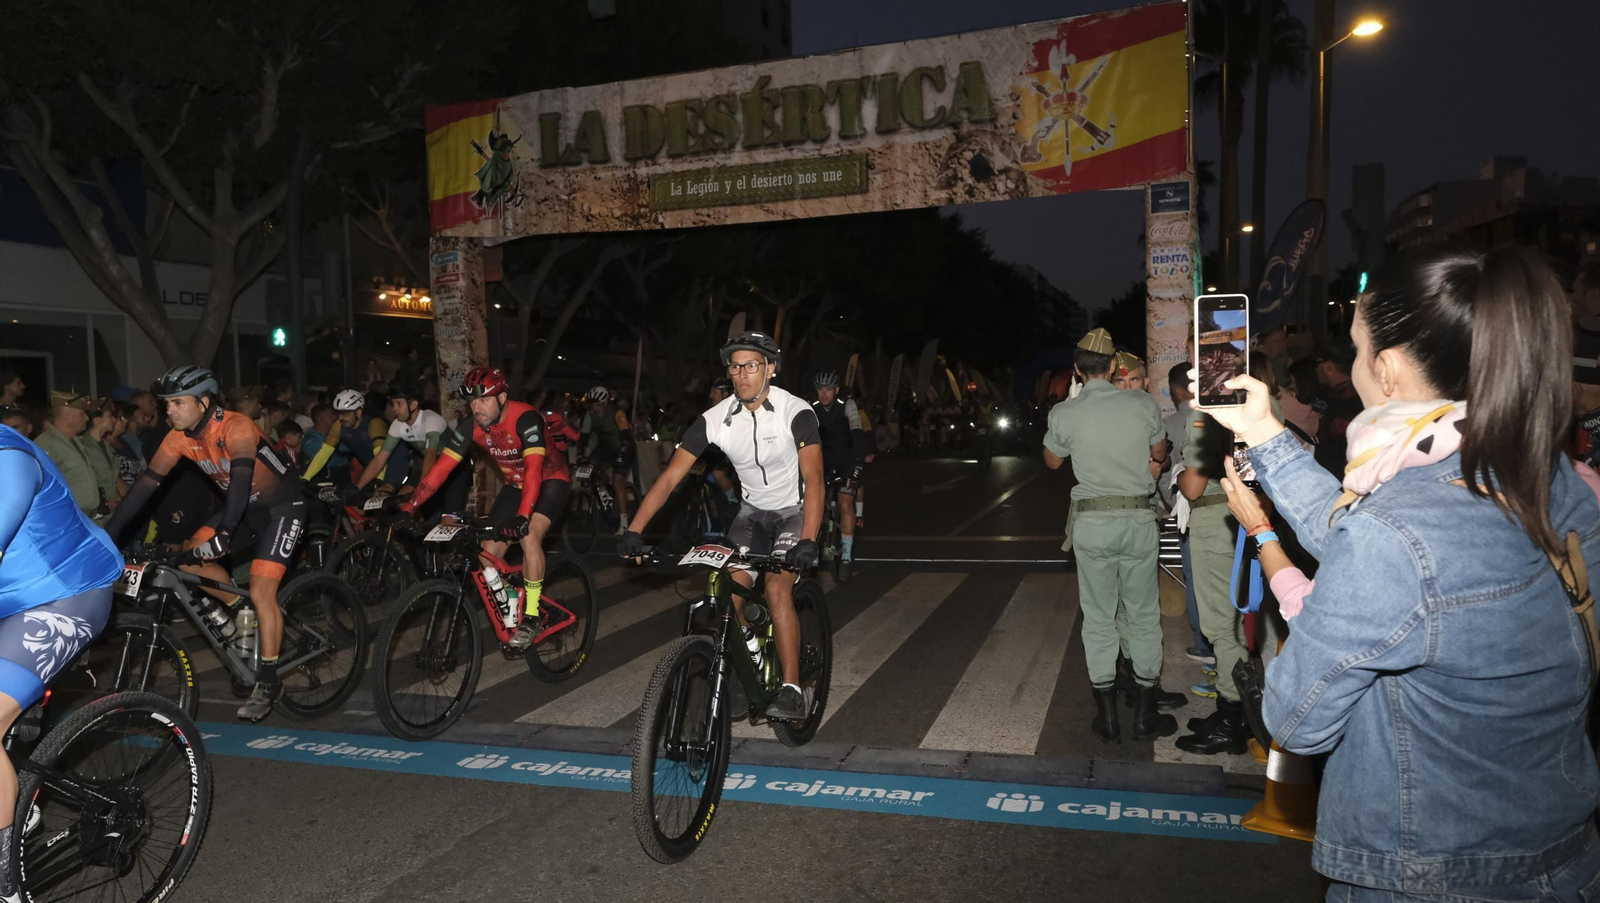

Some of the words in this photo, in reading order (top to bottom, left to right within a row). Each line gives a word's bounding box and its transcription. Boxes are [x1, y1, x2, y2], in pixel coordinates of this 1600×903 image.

[538, 110, 611, 169] LA
[622, 60, 998, 162] DESÉRTICA
[670, 182, 682, 196] La
[686, 179, 720, 197] Legión
[724, 180, 732, 194] y
[736, 176, 747, 190] el
[750, 173, 793, 188] desierto
[798, 172, 818, 185] nos
[822, 169, 843, 183] une
[1152, 246, 1189, 254] GRUPO
[1152, 253, 1190, 265] RENTA
[279, 518, 301, 558] Cartago
[691, 550, 725, 562] 7049
[477, 571, 507, 632] ORBEA
[189, 599, 232, 652] TREK
[178, 649, 194, 688] MAXXIS
[293, 742, 424, 760] cajamar
[185, 747, 199, 787] RAPID
[510, 761, 658, 779] cajama
[189, 786, 199, 816] ZTR
[764, 780, 935, 802] cajamar
[840, 796, 876, 804] CAJA
[878, 798, 924, 807] RURAL
[694, 801, 715, 842] MAXXIS
[1151, 819, 1192, 828] CAJA
